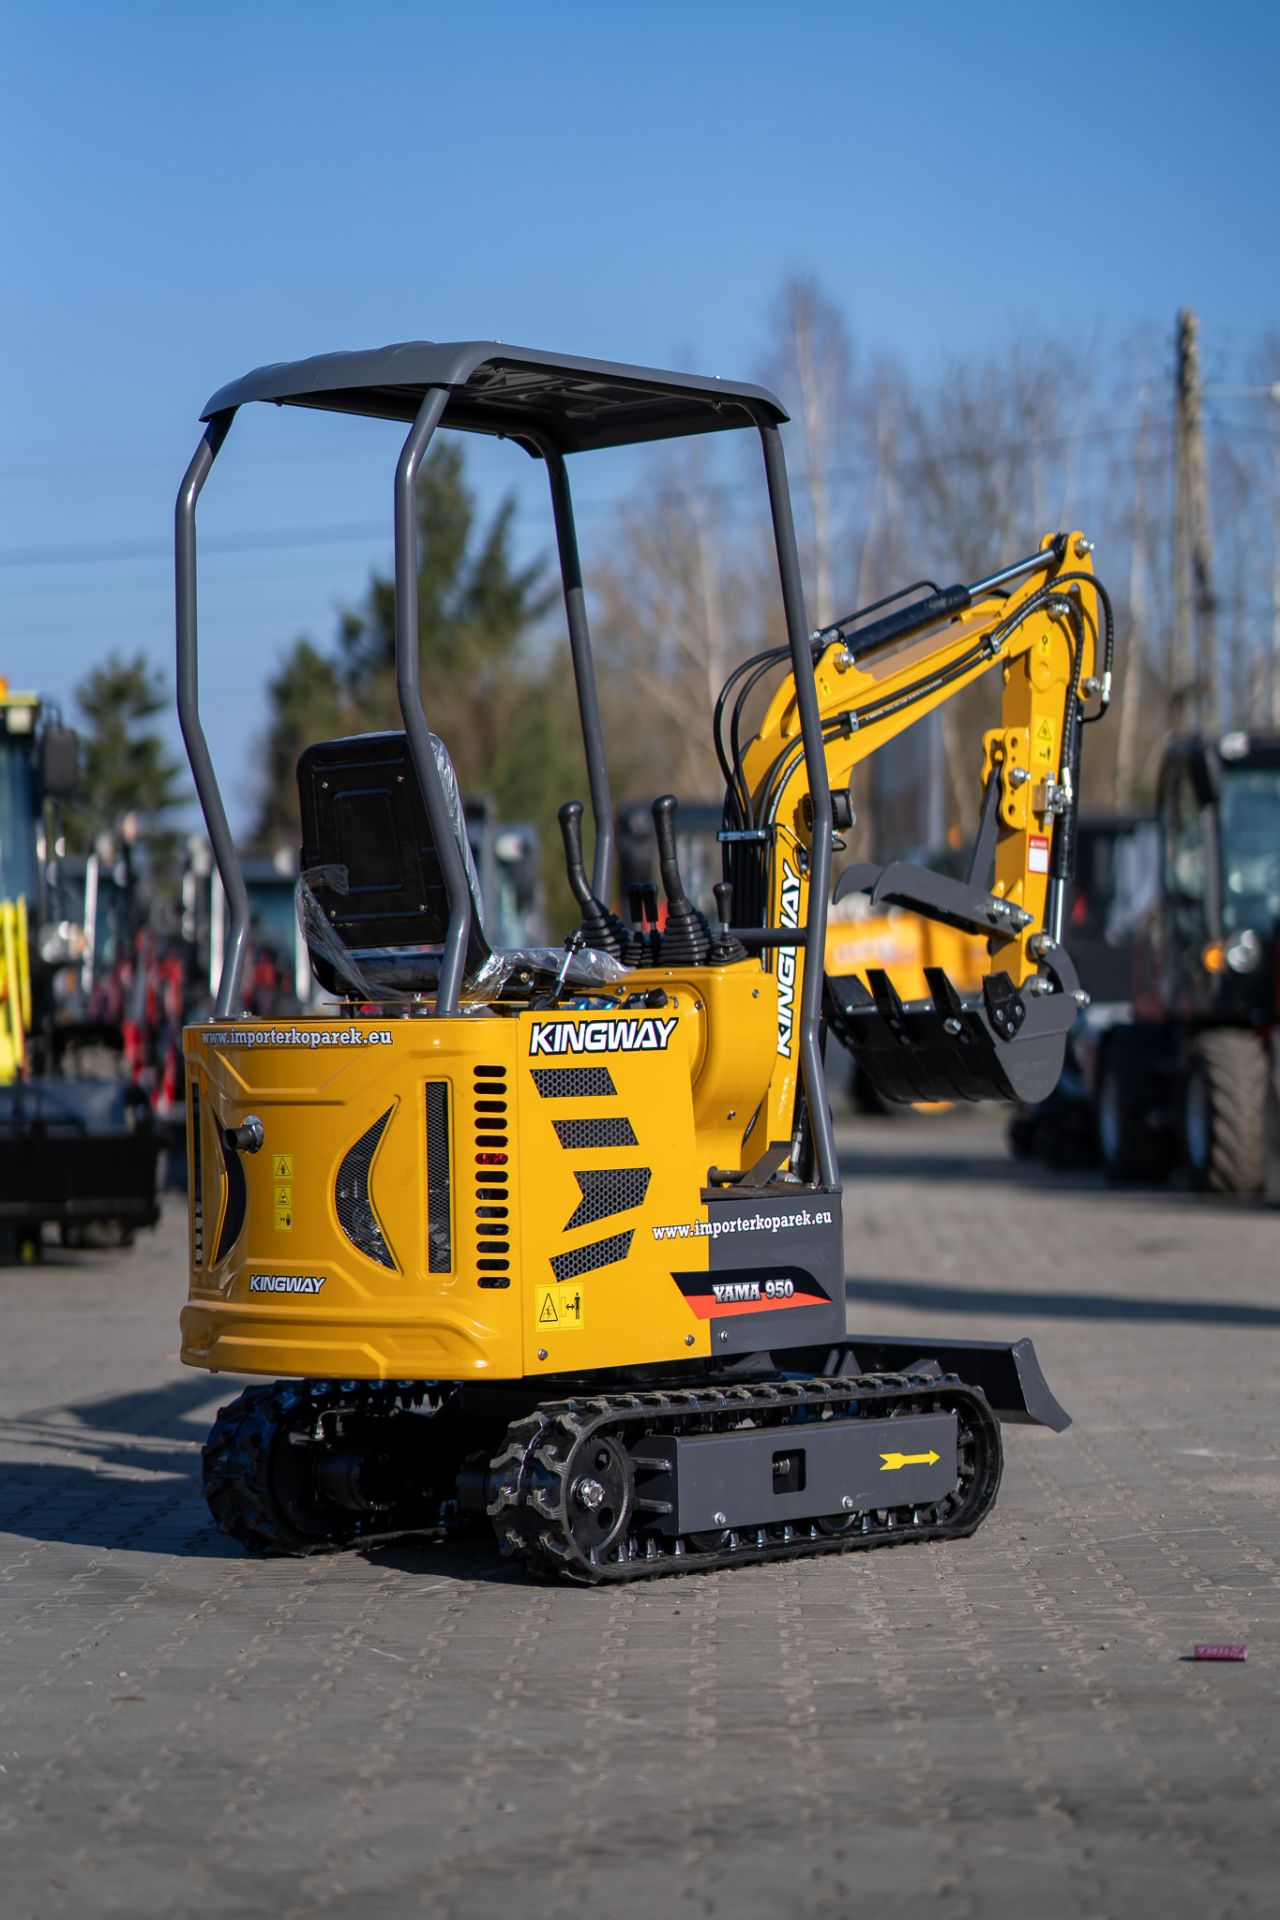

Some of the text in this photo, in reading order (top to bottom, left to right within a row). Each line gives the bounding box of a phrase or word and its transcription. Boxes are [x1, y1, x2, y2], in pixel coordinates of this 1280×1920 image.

[202, 1027, 392, 1048] www.importerkoparek.eu
[529, 1017, 679, 1056] KINGWAY
[652, 1210, 832, 1240] www.importerkoparek.eu
[250, 1275, 327, 1294] KINGWAY
[712, 1279, 794, 1303] YAMA 950
